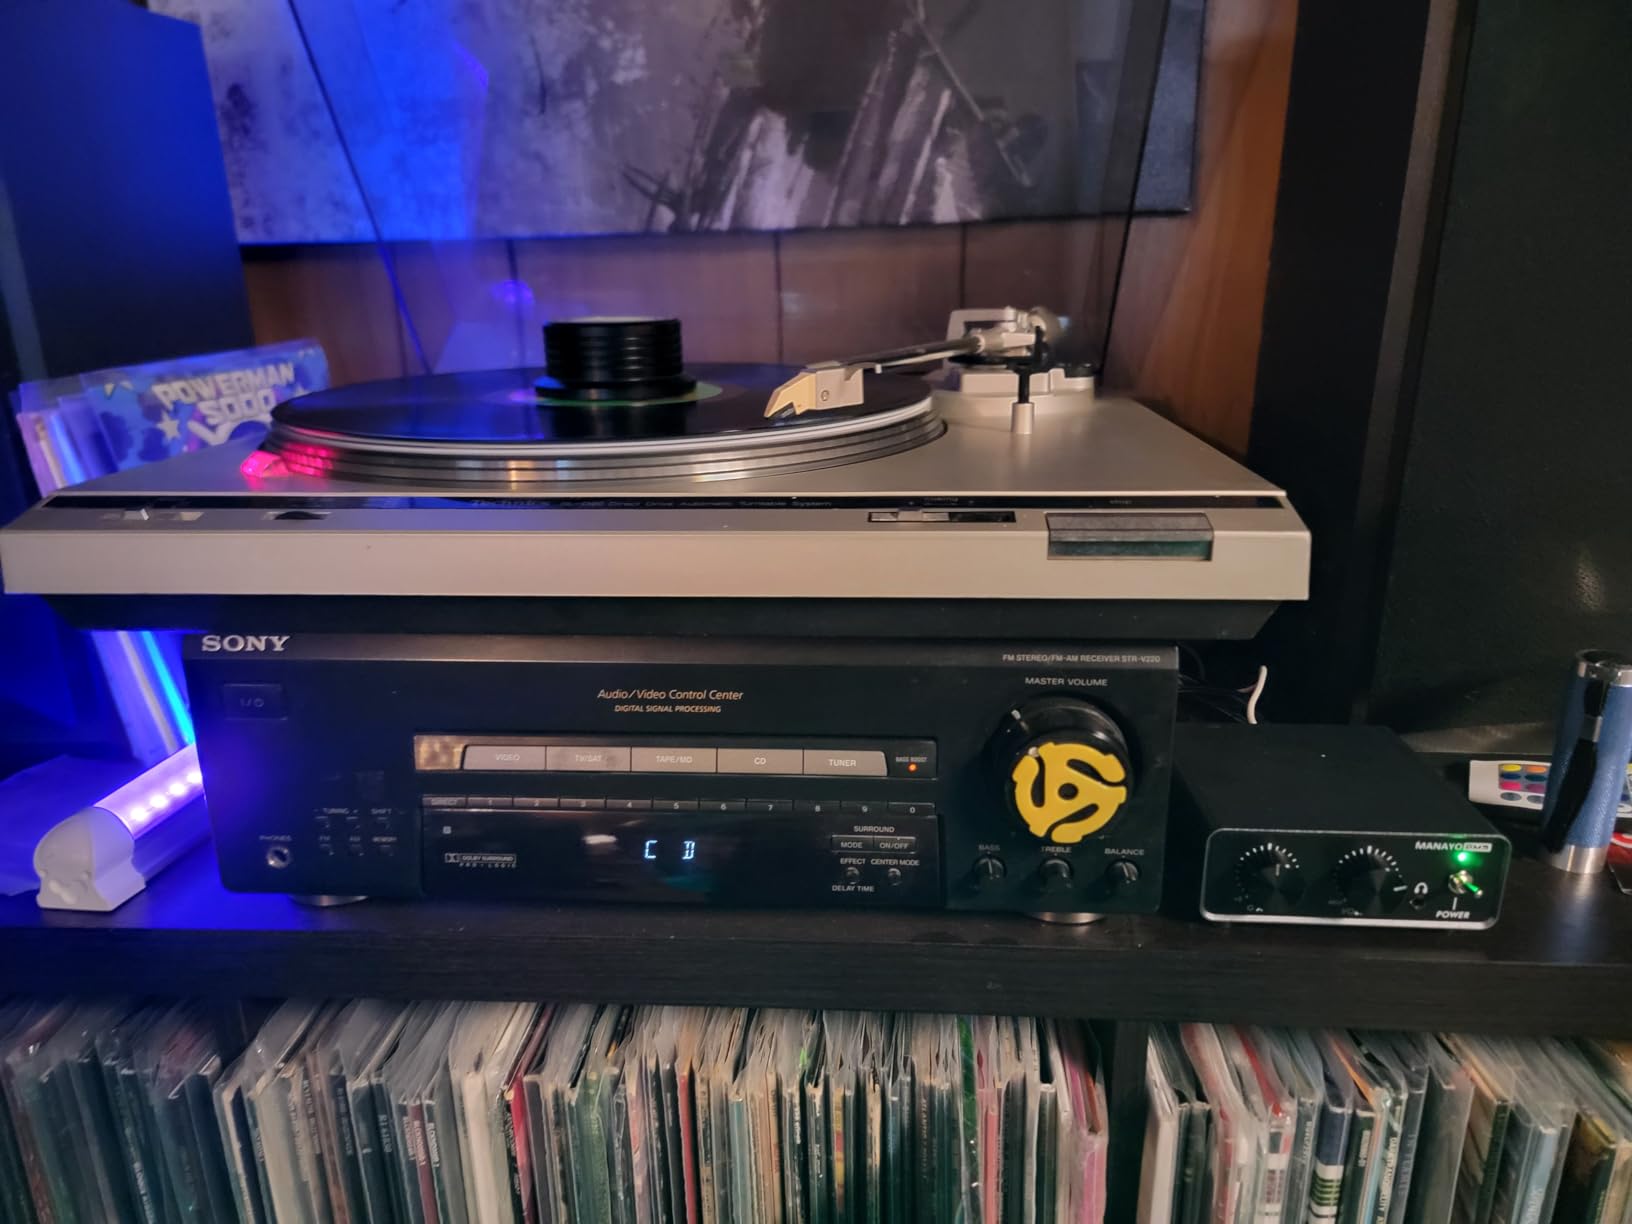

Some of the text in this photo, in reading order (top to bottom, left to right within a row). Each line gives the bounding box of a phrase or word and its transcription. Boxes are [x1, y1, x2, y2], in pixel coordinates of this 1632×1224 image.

[152, 361, 295, 411] POWERMAN
[201, 634, 290, 652] SONY
[1002, 654, 1015, 662] FM
[1024, 677, 1108, 687] MASTER VOLUME
[597, 689, 744, 701] Audio/Video Control Center
[614, 704, 722, 713] DIGITAL SIGNAL PROCESSING
[495, 753, 521, 761] VIDEO
[655, 755, 693, 764] TAPE/MD
[753, 757, 767, 765] CD
[828, 759, 857, 767] TUNER
[853, 825, 895, 833] SURROUND
[840, 841, 863, 849] MODE
[879, 842, 909, 850] ON/OFF
[1041, 846, 1072, 854] TREBLE
[1104, 847, 1145, 856] BALANCE
[870, 858, 899, 866] CENTER
[832, 884, 855, 892] DELAY
[1435, 910, 1471, 919] POWER
